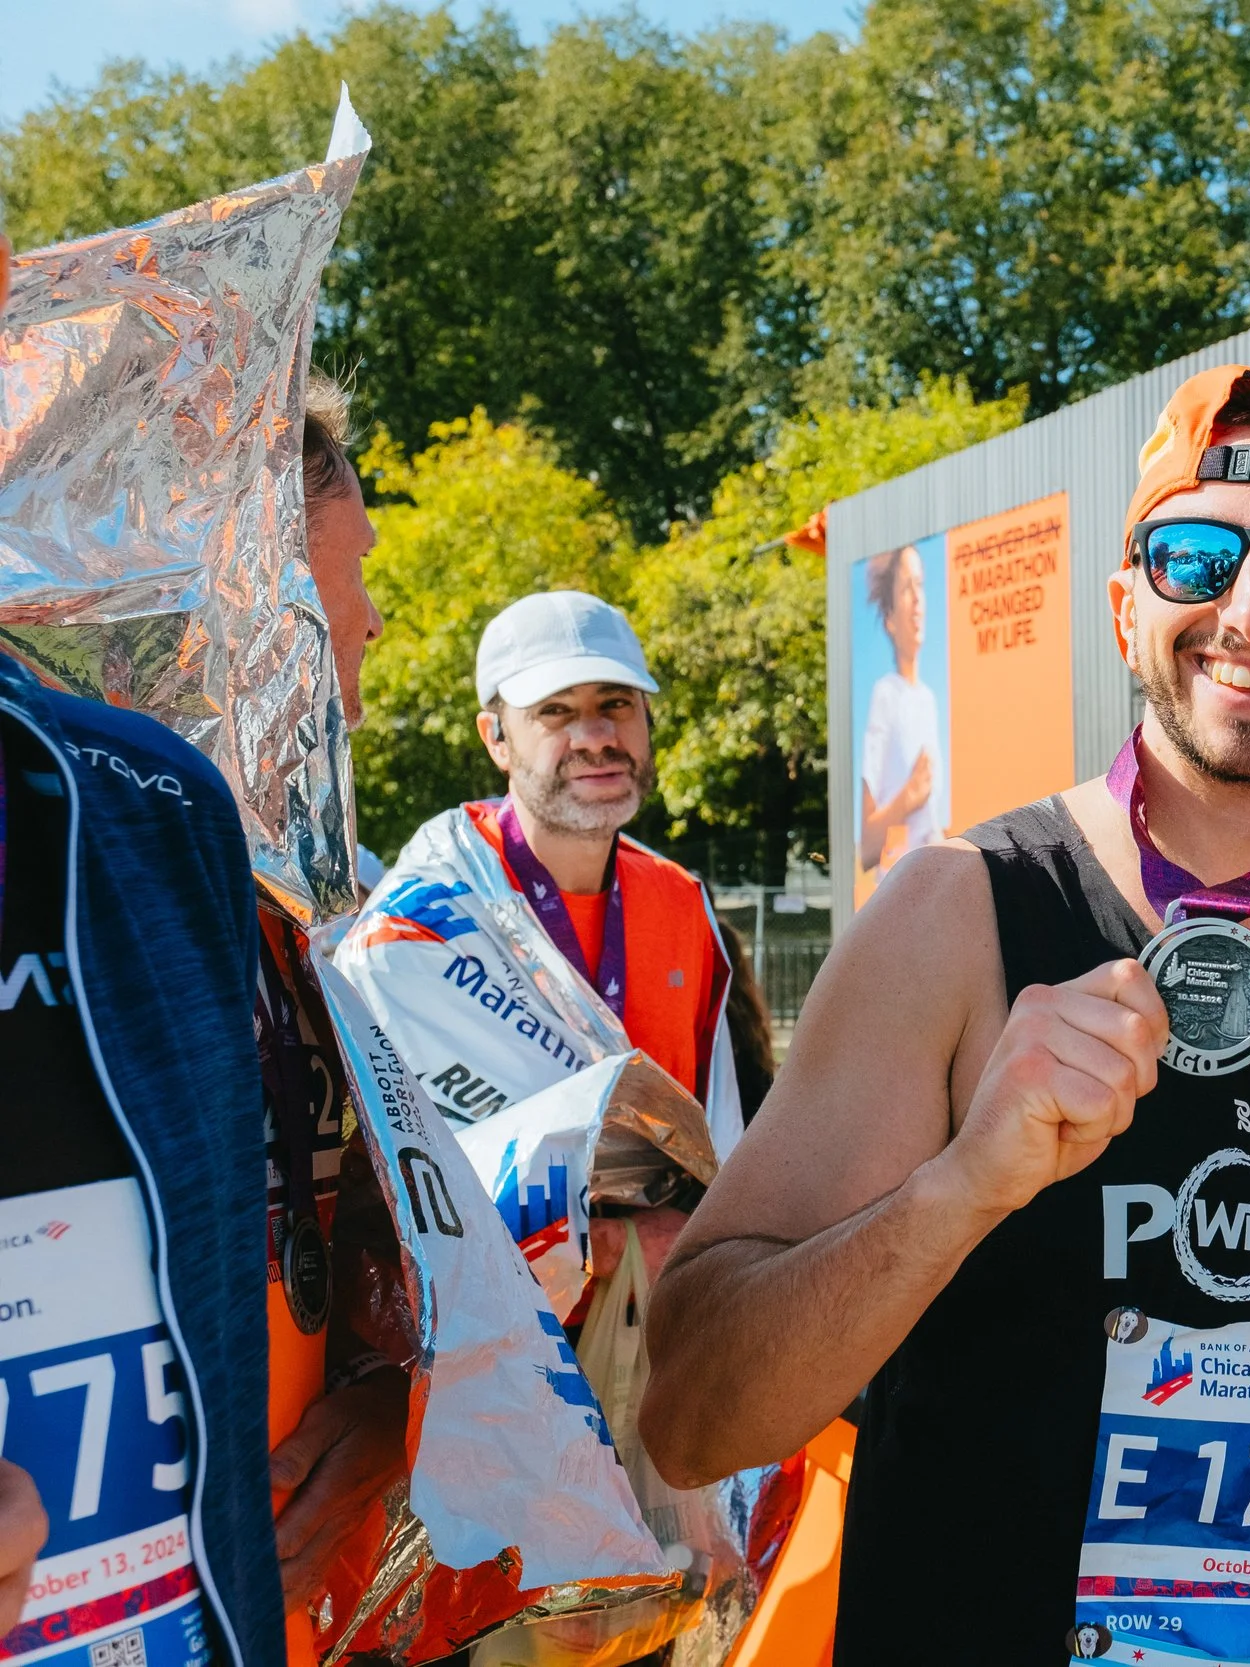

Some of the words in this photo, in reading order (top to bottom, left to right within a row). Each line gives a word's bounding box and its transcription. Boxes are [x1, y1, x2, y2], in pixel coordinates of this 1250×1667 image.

[959, 574, 969, 600] A
[972, 549, 1058, 595] MARATHON
[970, 584, 1044, 626] CHANGED
[977, 627, 998, 655] MY
[370, 1052, 405, 1133] ABBOTT
[1200, 1342, 1230, 1352] BANK
[1234, 1343, 1247, 1352] OF
[0, 1340, 189, 1522] 75
[1098, 1433, 1158, 1520] E
[101, 1552, 135, 1578] 13,
[142, 1530, 185, 1565] 2024
[1106, 1614, 1152, 1631] ROW
[1158, 1616, 1182, 1632] 29
